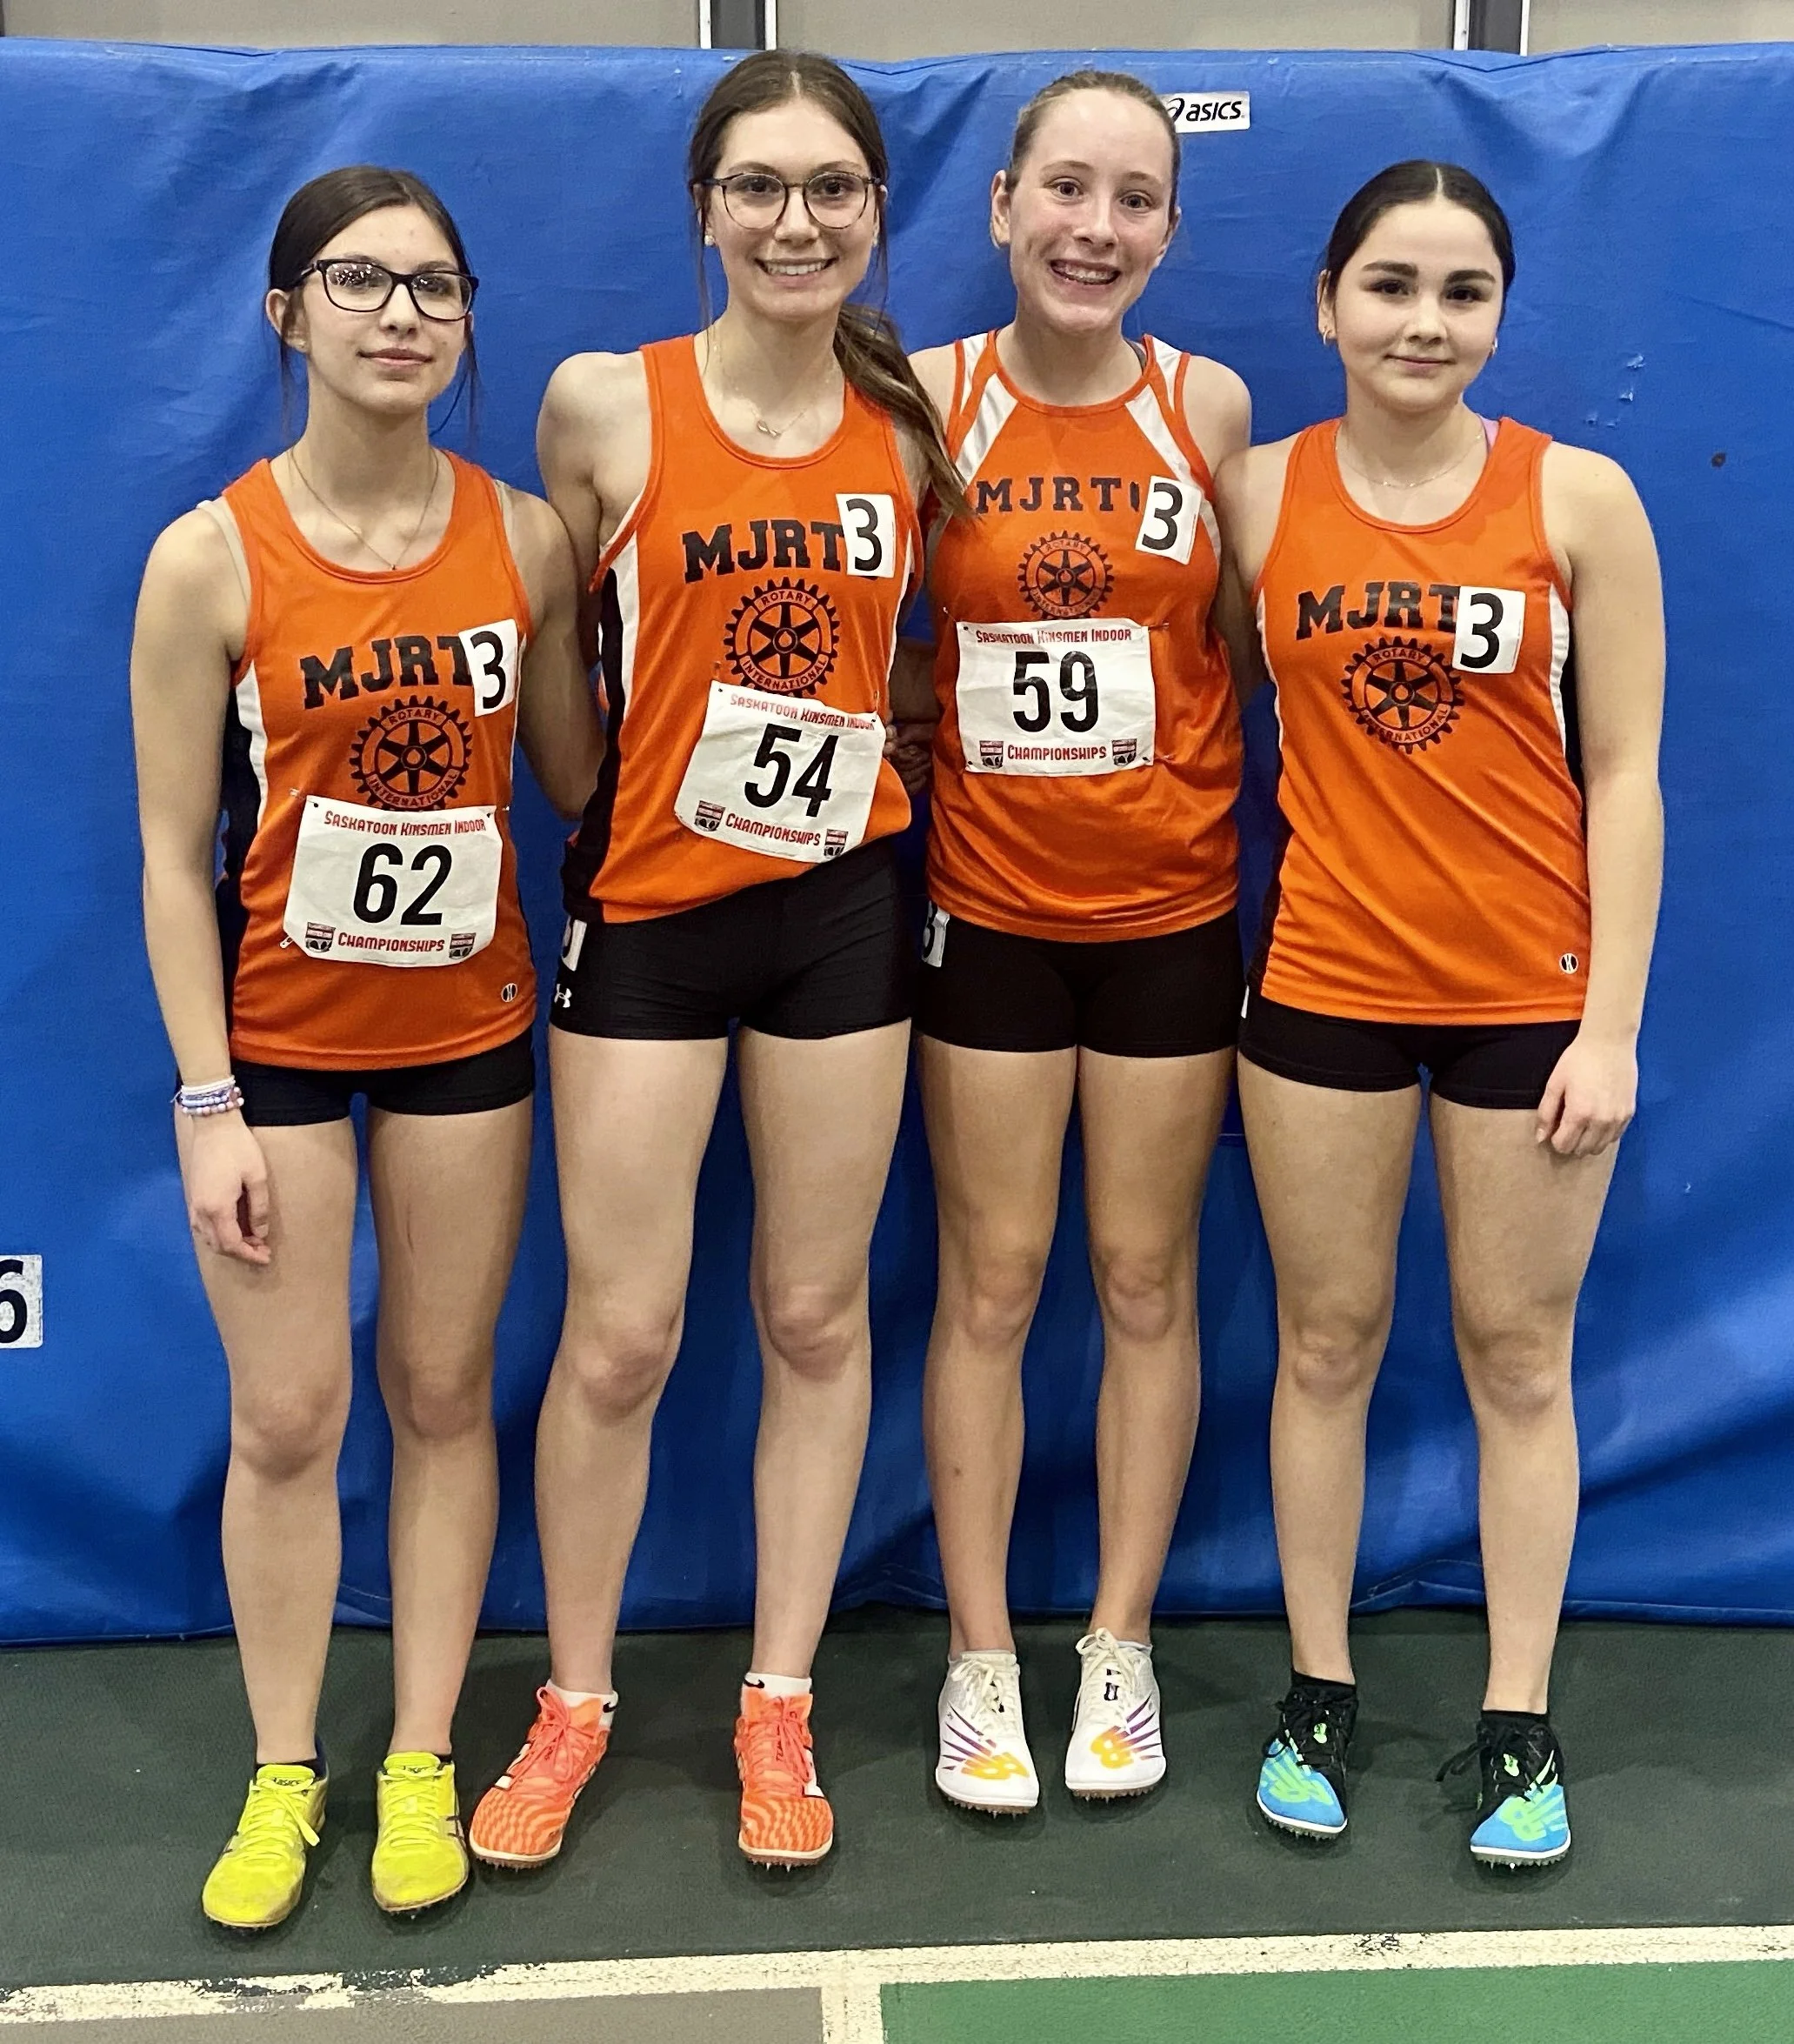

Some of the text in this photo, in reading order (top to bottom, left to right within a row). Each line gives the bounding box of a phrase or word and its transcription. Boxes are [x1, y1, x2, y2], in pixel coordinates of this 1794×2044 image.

[1141, 482, 1184, 551] 3
[846, 498, 882, 571] 3
[761, 591, 811, 605] ROTARY
[1091, 628, 1132, 642] INDOOR
[1460, 593, 1504, 668] 3
[470, 631, 506, 709] 3
[1372, 649, 1424, 662] ROTARY
[742, 659, 827, 689] INTERNATIONAL
[1013, 651, 1098, 732] 59
[389, 709, 441, 725] ROTARY
[730, 693, 798, 720] SASKATOON
[800, 707, 845, 727] KINSMEN
[1007, 745, 1107, 761] CHAMPIONSHIPS
[745, 724, 838, 817] 54
[370, 773, 457, 807] INTERNATIONAL
[324, 810, 486, 836] SASKATOON KINSMEN INDOOR
[725, 812, 821, 846] CHAMPIONSHIPS
[354, 844, 451, 925] 62
[338, 932, 445, 952] CHAMPIONSHIPS
